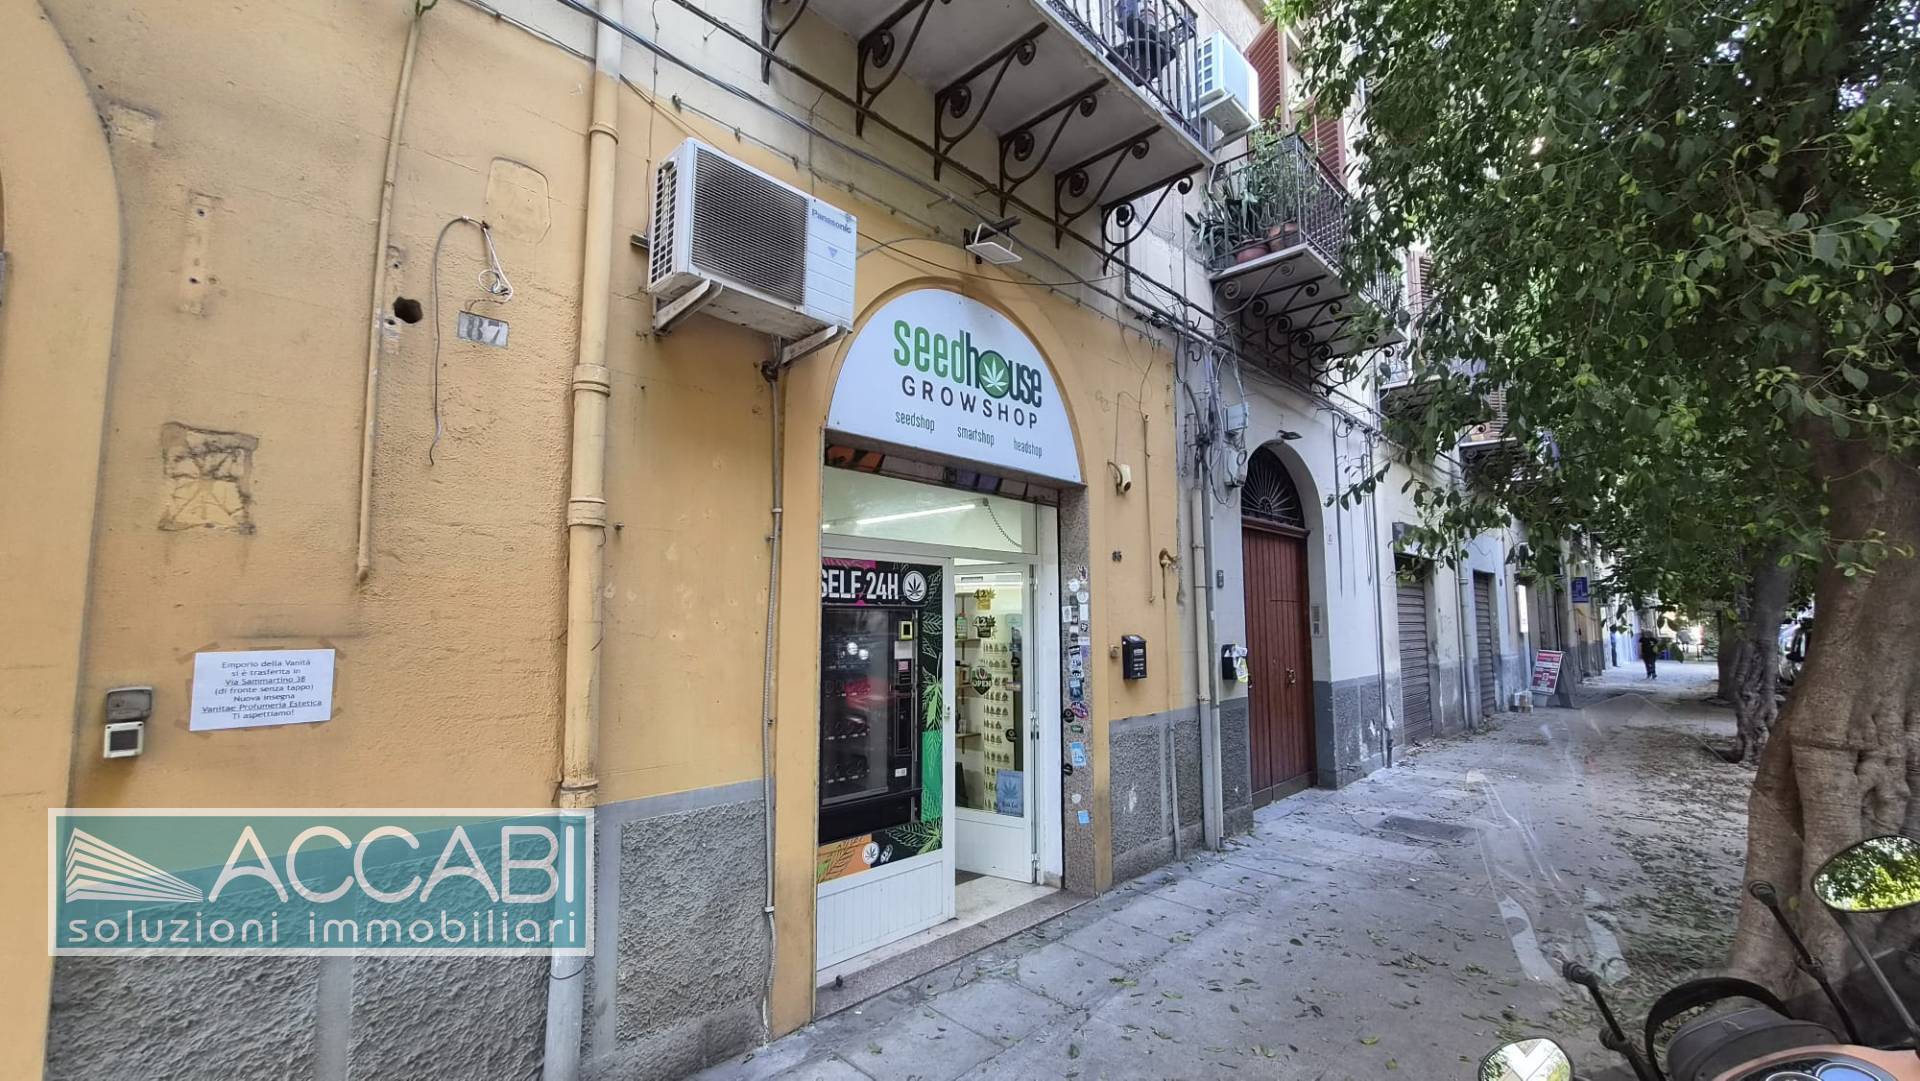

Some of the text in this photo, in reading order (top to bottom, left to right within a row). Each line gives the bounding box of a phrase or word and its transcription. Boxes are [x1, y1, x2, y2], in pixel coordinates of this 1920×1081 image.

[811, 209, 852, 234] Panasonic
[466, 317, 500, 344] 87
[893, 320, 1042, 407] seedhouse
[902, 375, 1038, 429] GROWSHOP
[895, 410, 935, 433] seedshop
[957, 426, 995, 446] smartshop
[1013, 439, 1043, 458] headshop
[821, 568, 899, 600] SELF 24H
[222, 661, 259, 669] Emporio
[261, 659, 282, 668] della
[225, 678, 240, 687] Via
[241, 676, 294, 686] Sammartino
[229, 685, 258, 694] fronte
[260, 684, 285, 693] senza
[233, 694, 261, 702] Nuova
[239, 702, 287, 712] Profumeria
[289, 699, 323, 708] Estetica
[232, 709, 295, 719] Ti aspettiamo!
